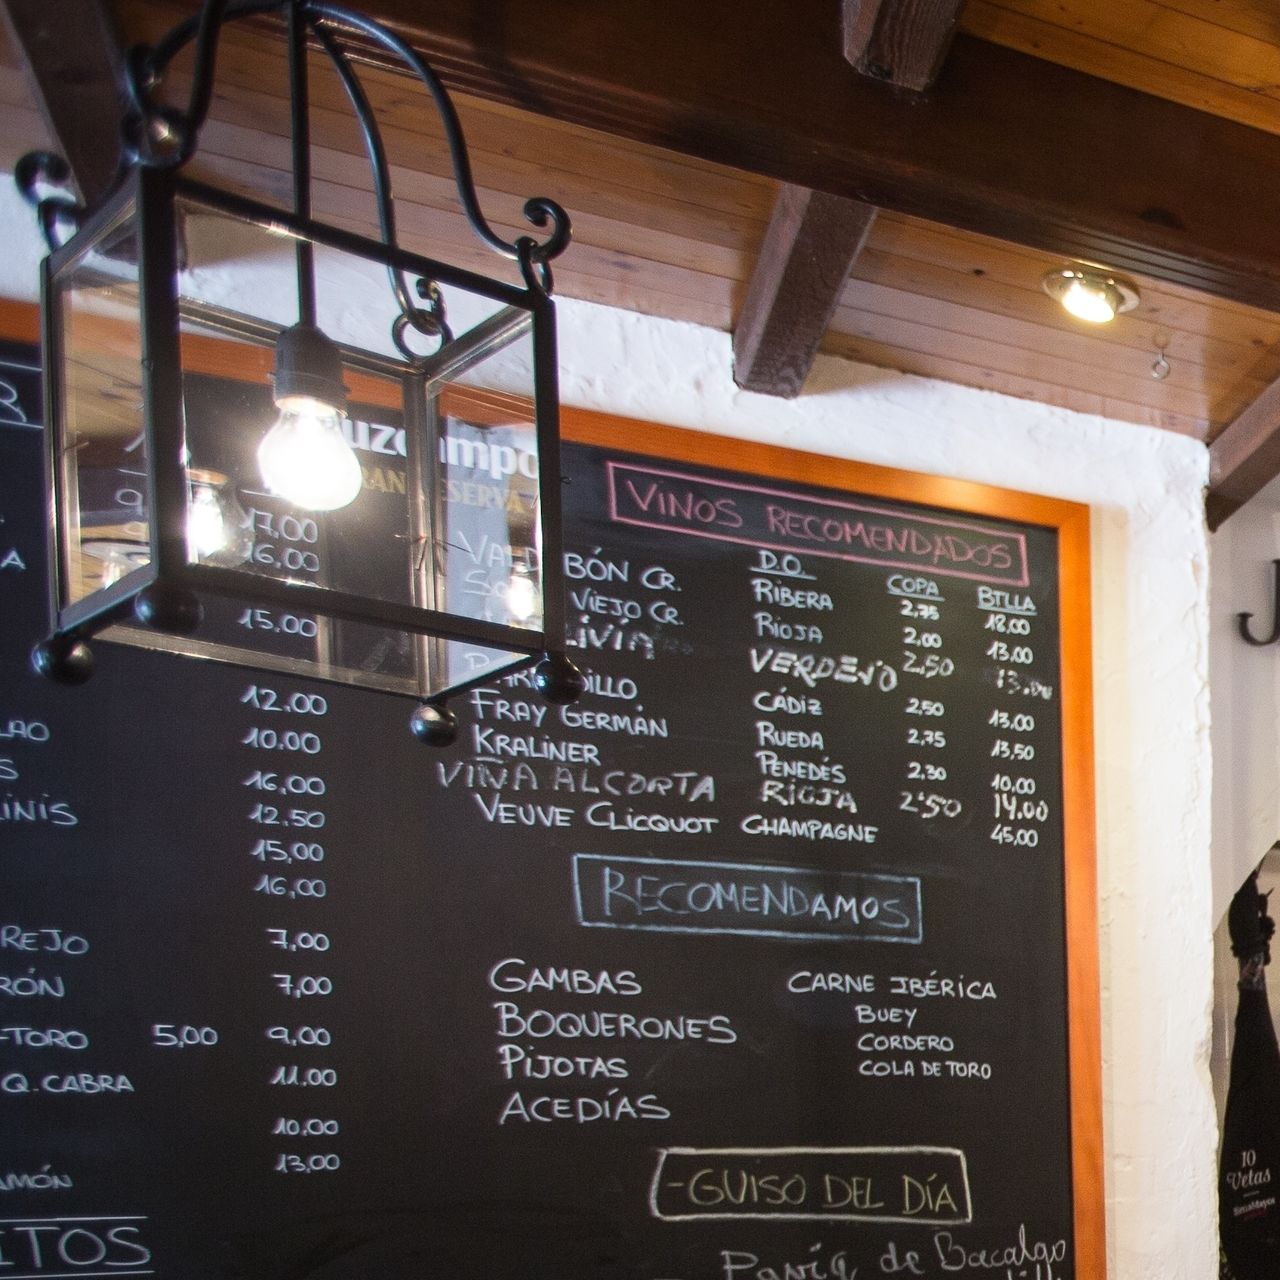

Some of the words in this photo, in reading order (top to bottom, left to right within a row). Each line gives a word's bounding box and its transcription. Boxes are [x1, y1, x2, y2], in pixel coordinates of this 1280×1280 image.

[625, 479, 743, 529] VINOS
[766, 504, 1013, 569] RECOMENDADOS
[752, 578, 834, 611] RIBERA
[887, 574, 940, 598] COPA
[571, 587, 642, 620] VIEJO
[238, 609, 318, 638] 15.00
[754, 612, 823, 644] RIOJA
[240, 685, 328, 716] 12.00
[470, 688, 548, 728] FRAY
[242, 727, 322, 754] 10.00
[756, 721, 824, 751] RUEDA
[553, 764, 716, 802] ALCORTA
[472, 792, 575, 827] VEUVE
[585, 800, 720, 833] CLICQUOT
[741, 814, 879, 844] CHAMPAGNE
[602, 867, 911, 927] RECOMENDAMOS
[490, 959, 642, 995] GAMBAS
[788, 971, 876, 994] CARNE
[890, 970, 997, 1000] IBÉRICA
[494, 1003, 737, 1043] BOQUERONES
[855, 1005, 917, 1029] BUEY
[857, 1033, 955, 1052] CORDERO
[500, 1045, 629, 1080] PIJOTAS
[859, 1060, 915, 1078] COLA
[921, 1061, 942, 1077] DE
[945, 1060, 992, 1080] TORO
[42, 1073, 135, 1094] CABRA
[500, 1088, 671, 1125] ACEDÍAS
[1242, 1149, 1257, 1168] 10
[822, 1174, 885, 1210] DEL
[902, 1173, 958, 1214] DÍA
[880, 1242, 920, 1274] de
